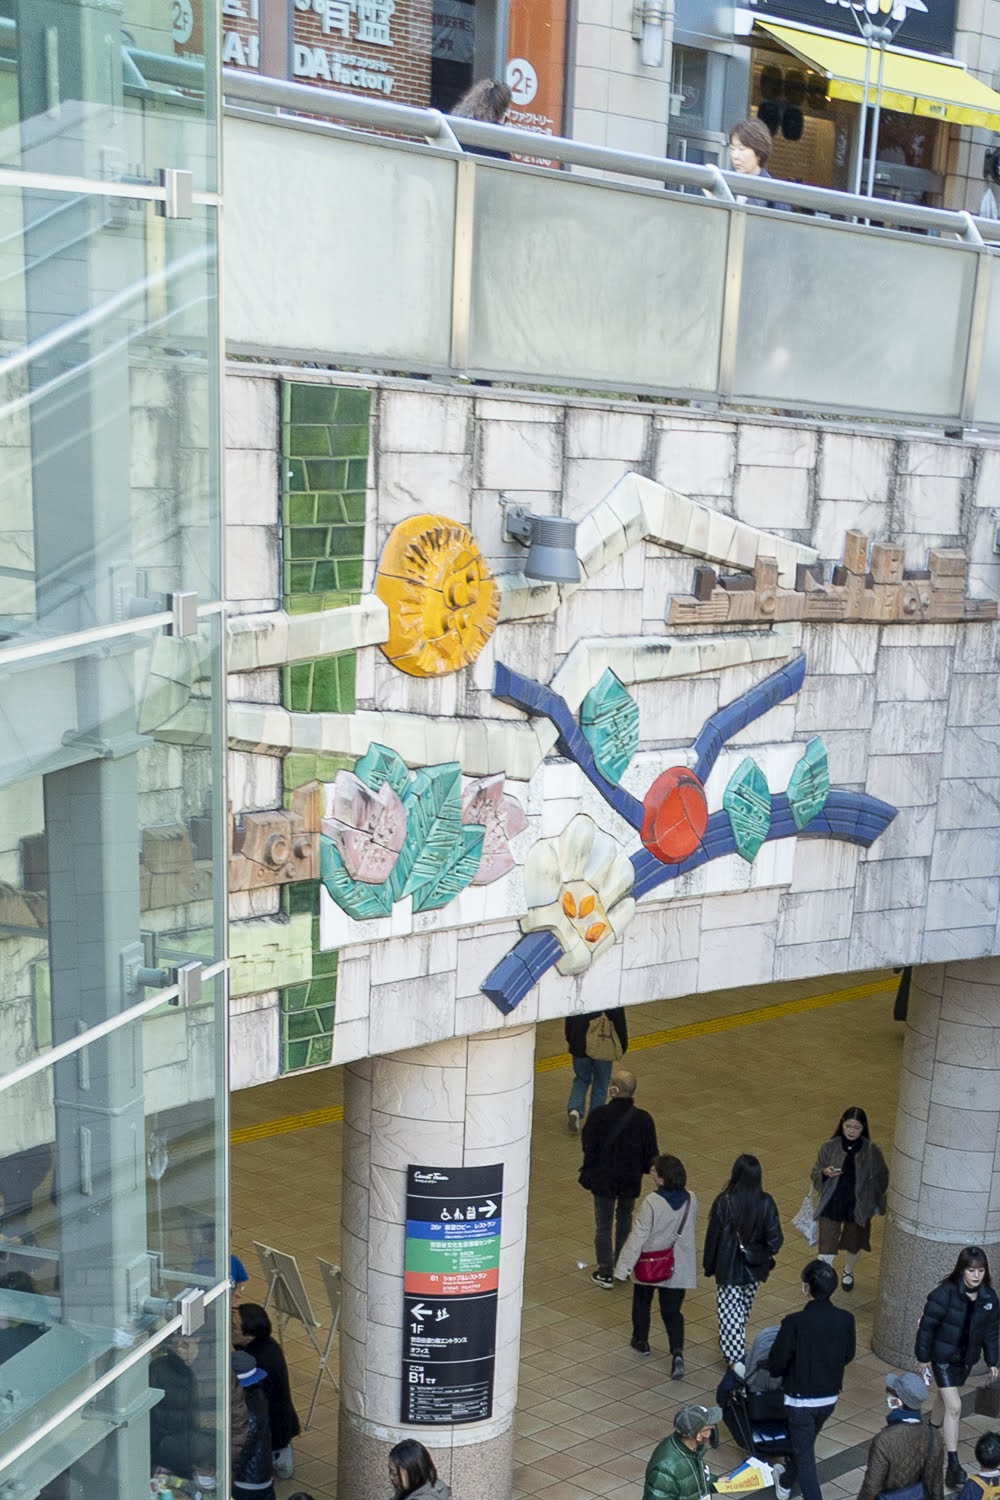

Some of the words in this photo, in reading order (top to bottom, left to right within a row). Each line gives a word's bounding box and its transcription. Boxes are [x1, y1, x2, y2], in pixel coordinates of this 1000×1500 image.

[331, 61, 395, 95] factory
[511, 67, 533, 95] 2F
[474, 1221, 497, 1230] レストラン
[410, 1322, 425, 1334] 1F
